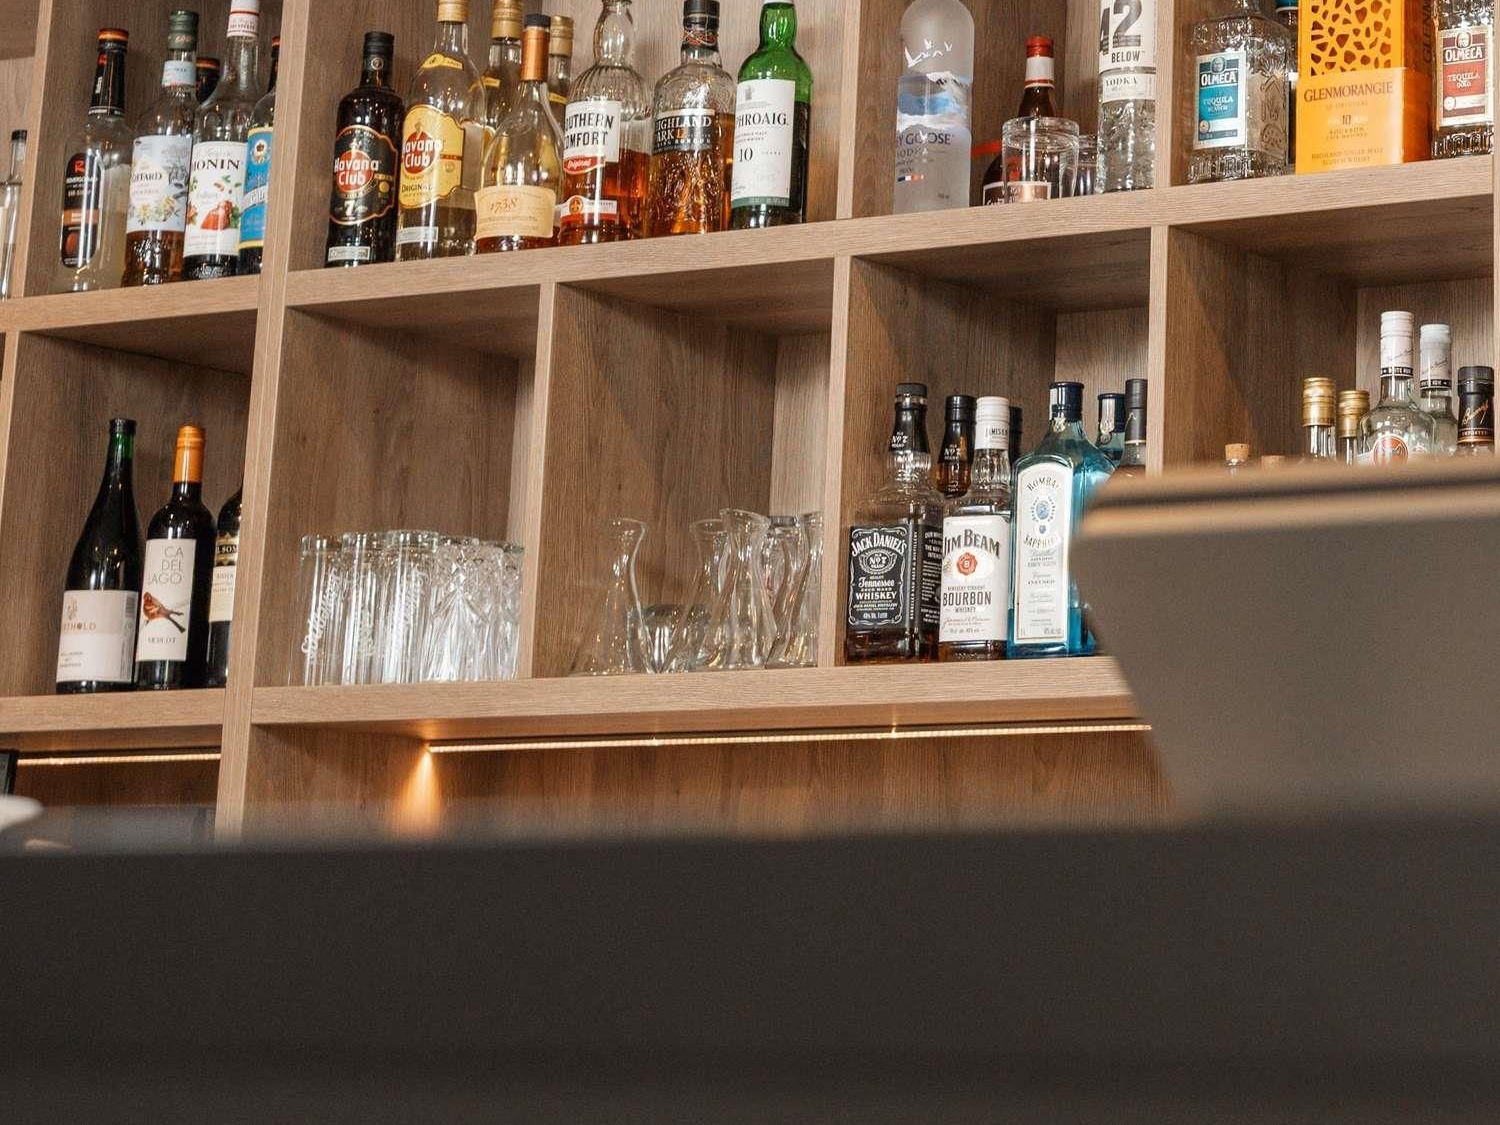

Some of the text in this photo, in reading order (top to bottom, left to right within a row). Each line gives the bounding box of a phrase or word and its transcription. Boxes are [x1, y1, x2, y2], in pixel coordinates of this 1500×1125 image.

[1110, 49, 1141, 64] BELOW
[1444, 46, 1484, 63] OLMECA
[1201, 70, 1237, 87] OLMECA
[1302, 80, 1394, 104] GLENMORANGIE
[405, 152, 432, 168] Club
[738, 147, 754, 163] 10
[334, 157, 380, 174] Havana
[338, 172, 366, 186] Club
[344, 200, 356, 217] 7
[851, 531, 908, 557] JACK DANIEL'S
[963, 528, 1001, 560] BEAM
[164, 545, 185, 560] CA
[161, 559, 184, 573] DEL
[858, 576, 896, 589] Tennessee
[855, 591, 898, 601] WHISKEY
[942, 591, 993, 607] BOURBON
